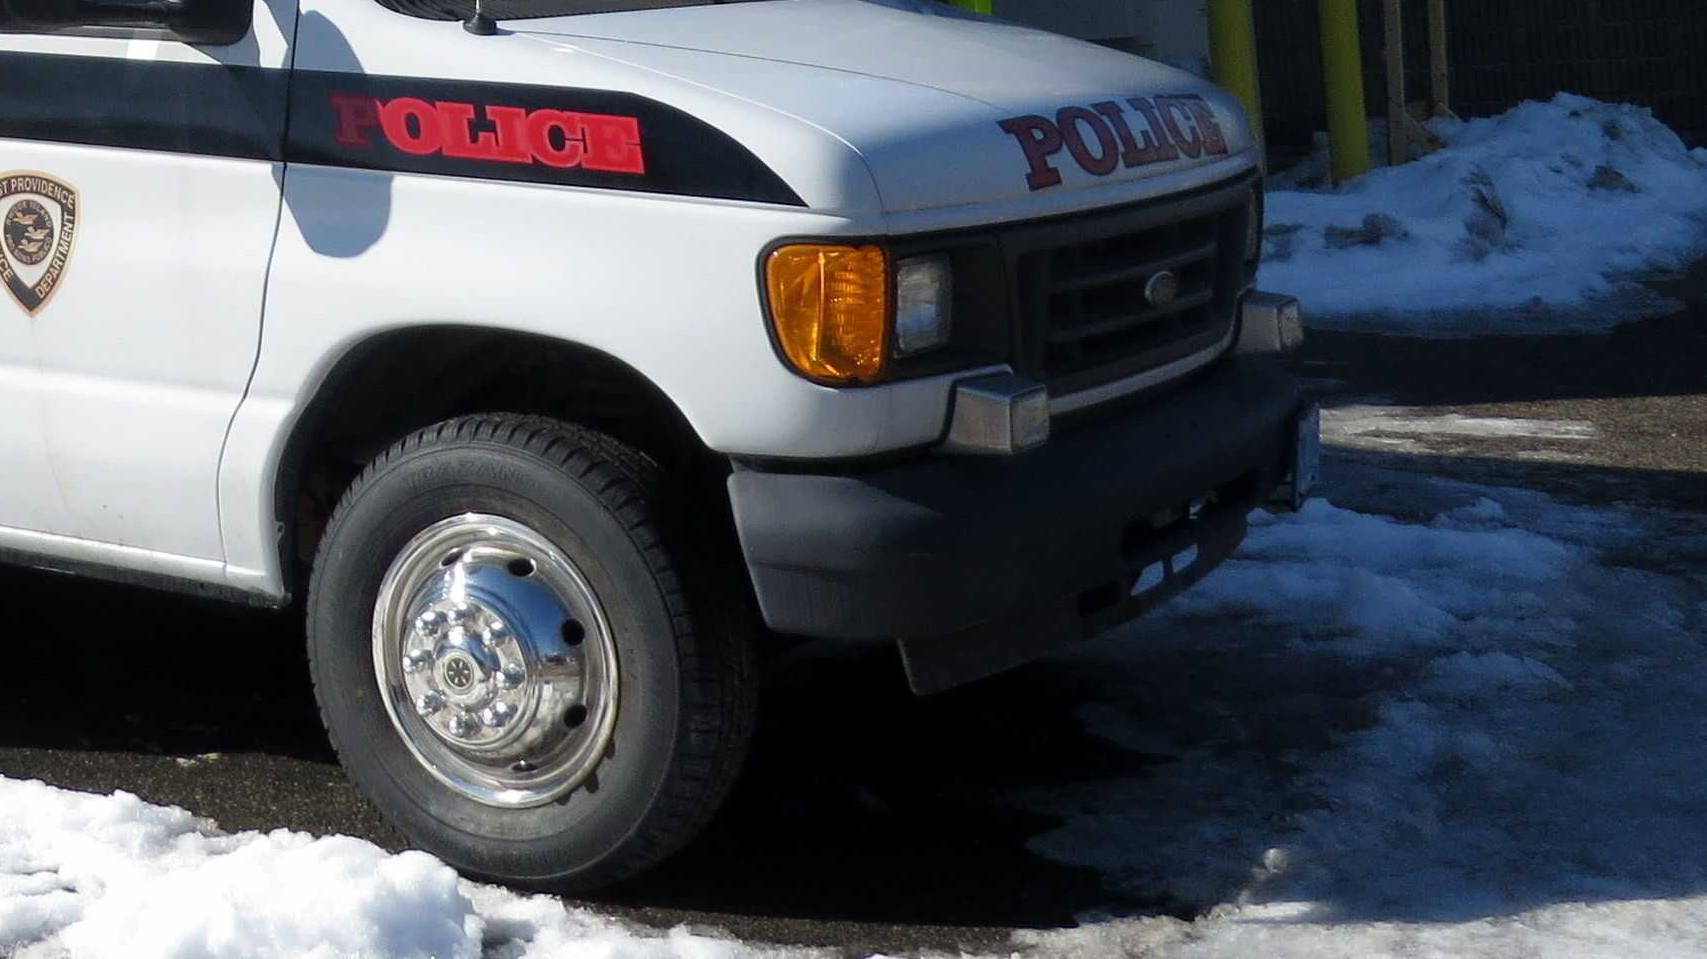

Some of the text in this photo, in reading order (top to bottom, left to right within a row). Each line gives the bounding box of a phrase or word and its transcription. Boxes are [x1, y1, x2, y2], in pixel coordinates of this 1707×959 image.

[327, 92, 646, 175] POLICE
[996, 92, 1229, 192] POLICE
[10, 177, 75, 210] PROVIDENCE
[35, 212, 75, 299] DEPARTMENT
